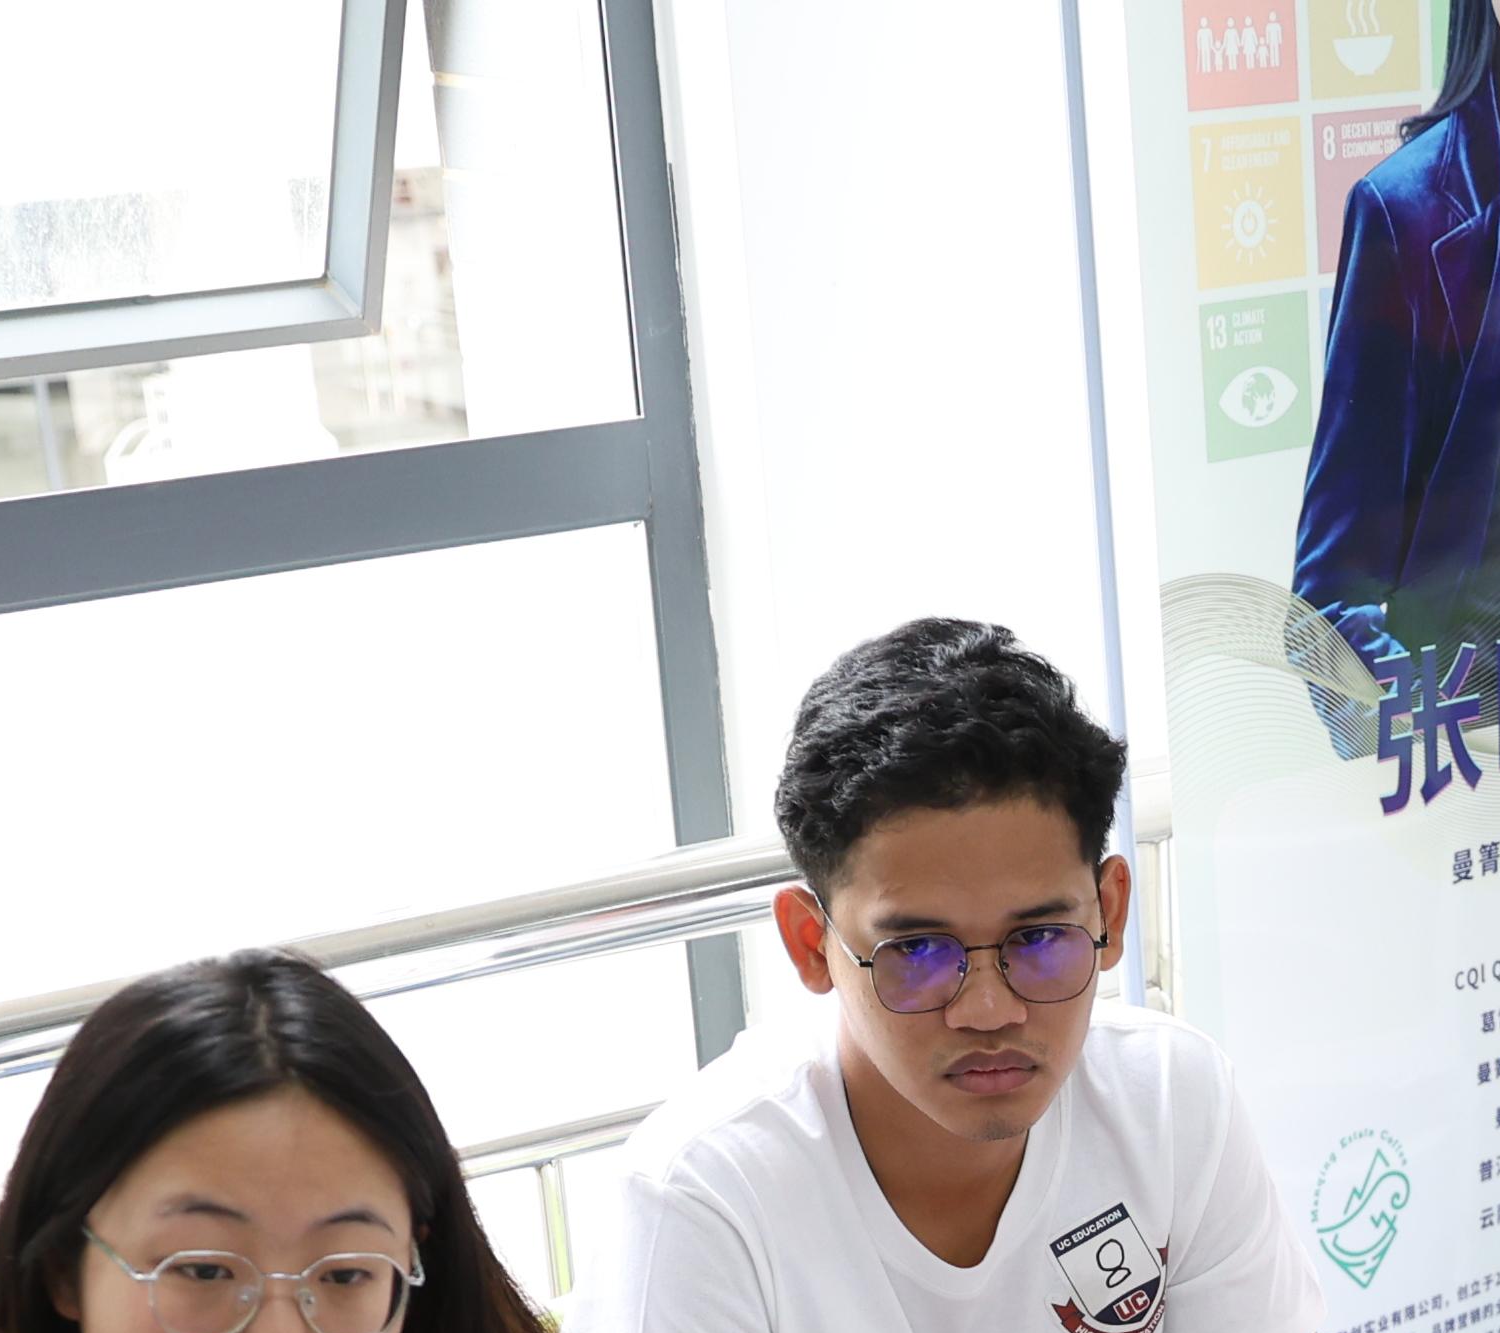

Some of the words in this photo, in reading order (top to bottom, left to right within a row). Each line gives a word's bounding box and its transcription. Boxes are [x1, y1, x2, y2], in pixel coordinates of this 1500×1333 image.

[1322, 125, 1337, 161] 8
[1341, 122, 1372, 139] DECENT
[1342, 139, 1384, 158] ECONOMIC
[1206, 314, 1227, 350] 13
[1057, 1237, 1072, 1250] UC
[1071, 1209, 1123, 1243] EDUCATION
[1096, 1239, 1132, 1288] 8
[1114, 1290, 1150, 1321] UC
